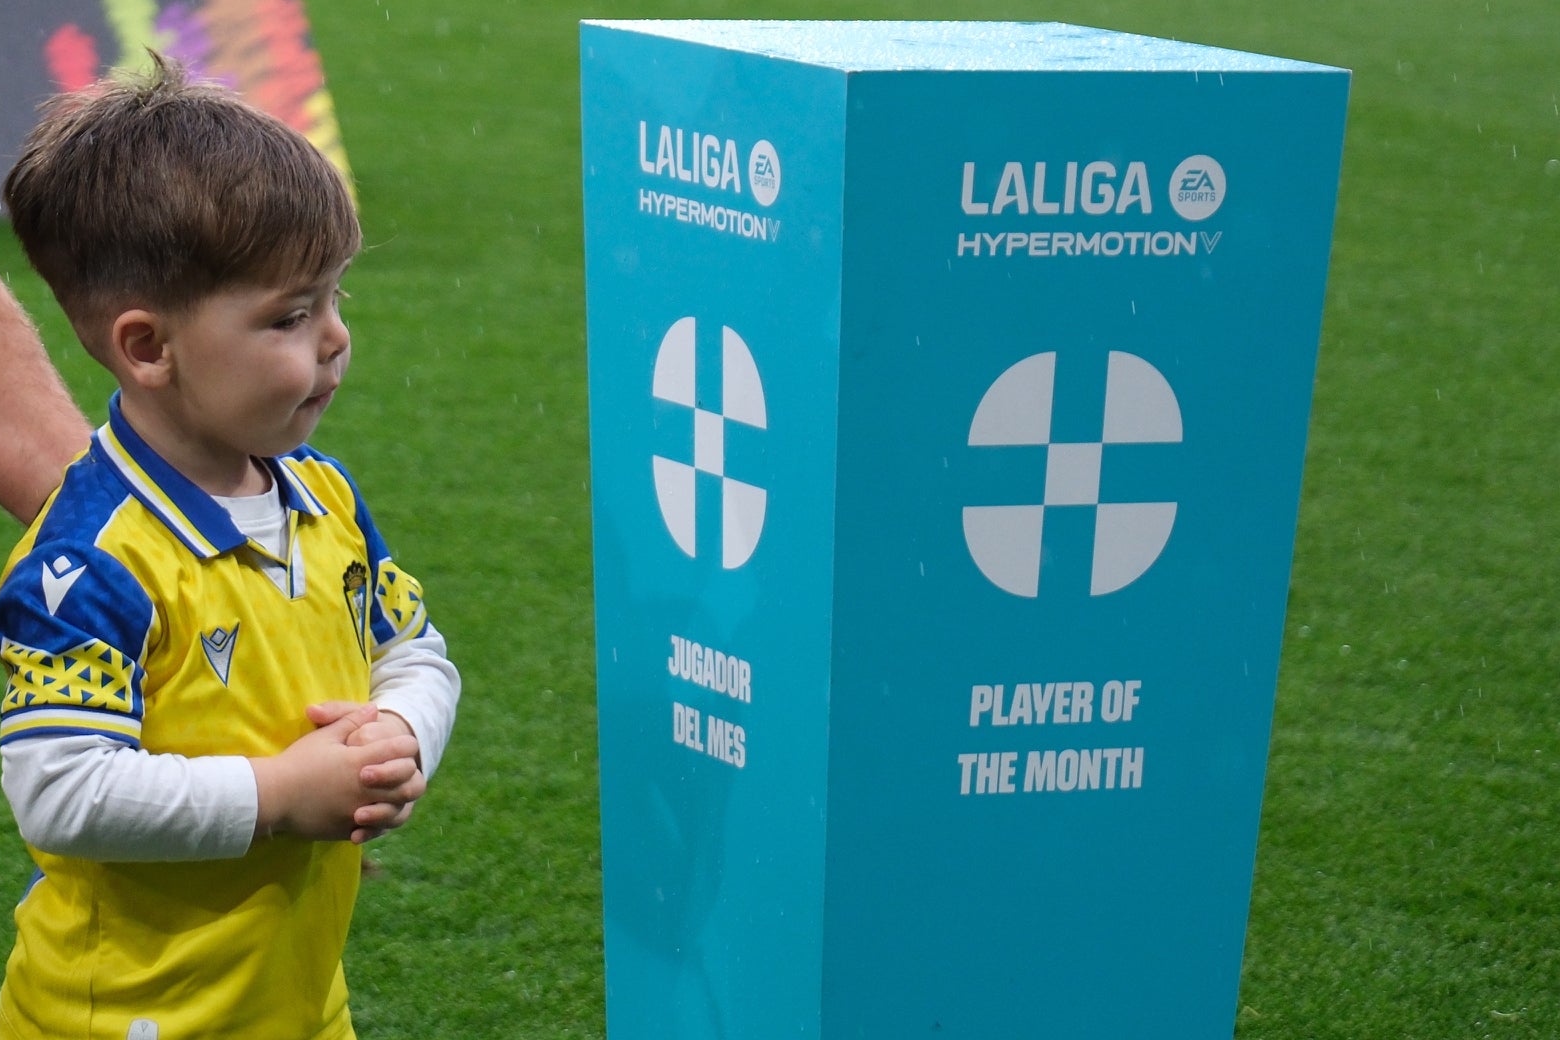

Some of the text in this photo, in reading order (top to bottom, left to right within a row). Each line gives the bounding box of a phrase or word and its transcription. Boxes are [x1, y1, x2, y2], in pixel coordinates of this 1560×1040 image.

[639, 120, 741, 193] LALIGA
[1179, 169, 1215, 191] EA
[961, 161, 1153, 215] LALIGA
[1177, 191, 1216, 203] SPORTS
[668, 634, 752, 704] JUGADOR
[969, 680, 1142, 727] PLAYER OF
[673, 701, 747, 769] DEL MES
[957, 747, 1145, 795] THE MONTH
